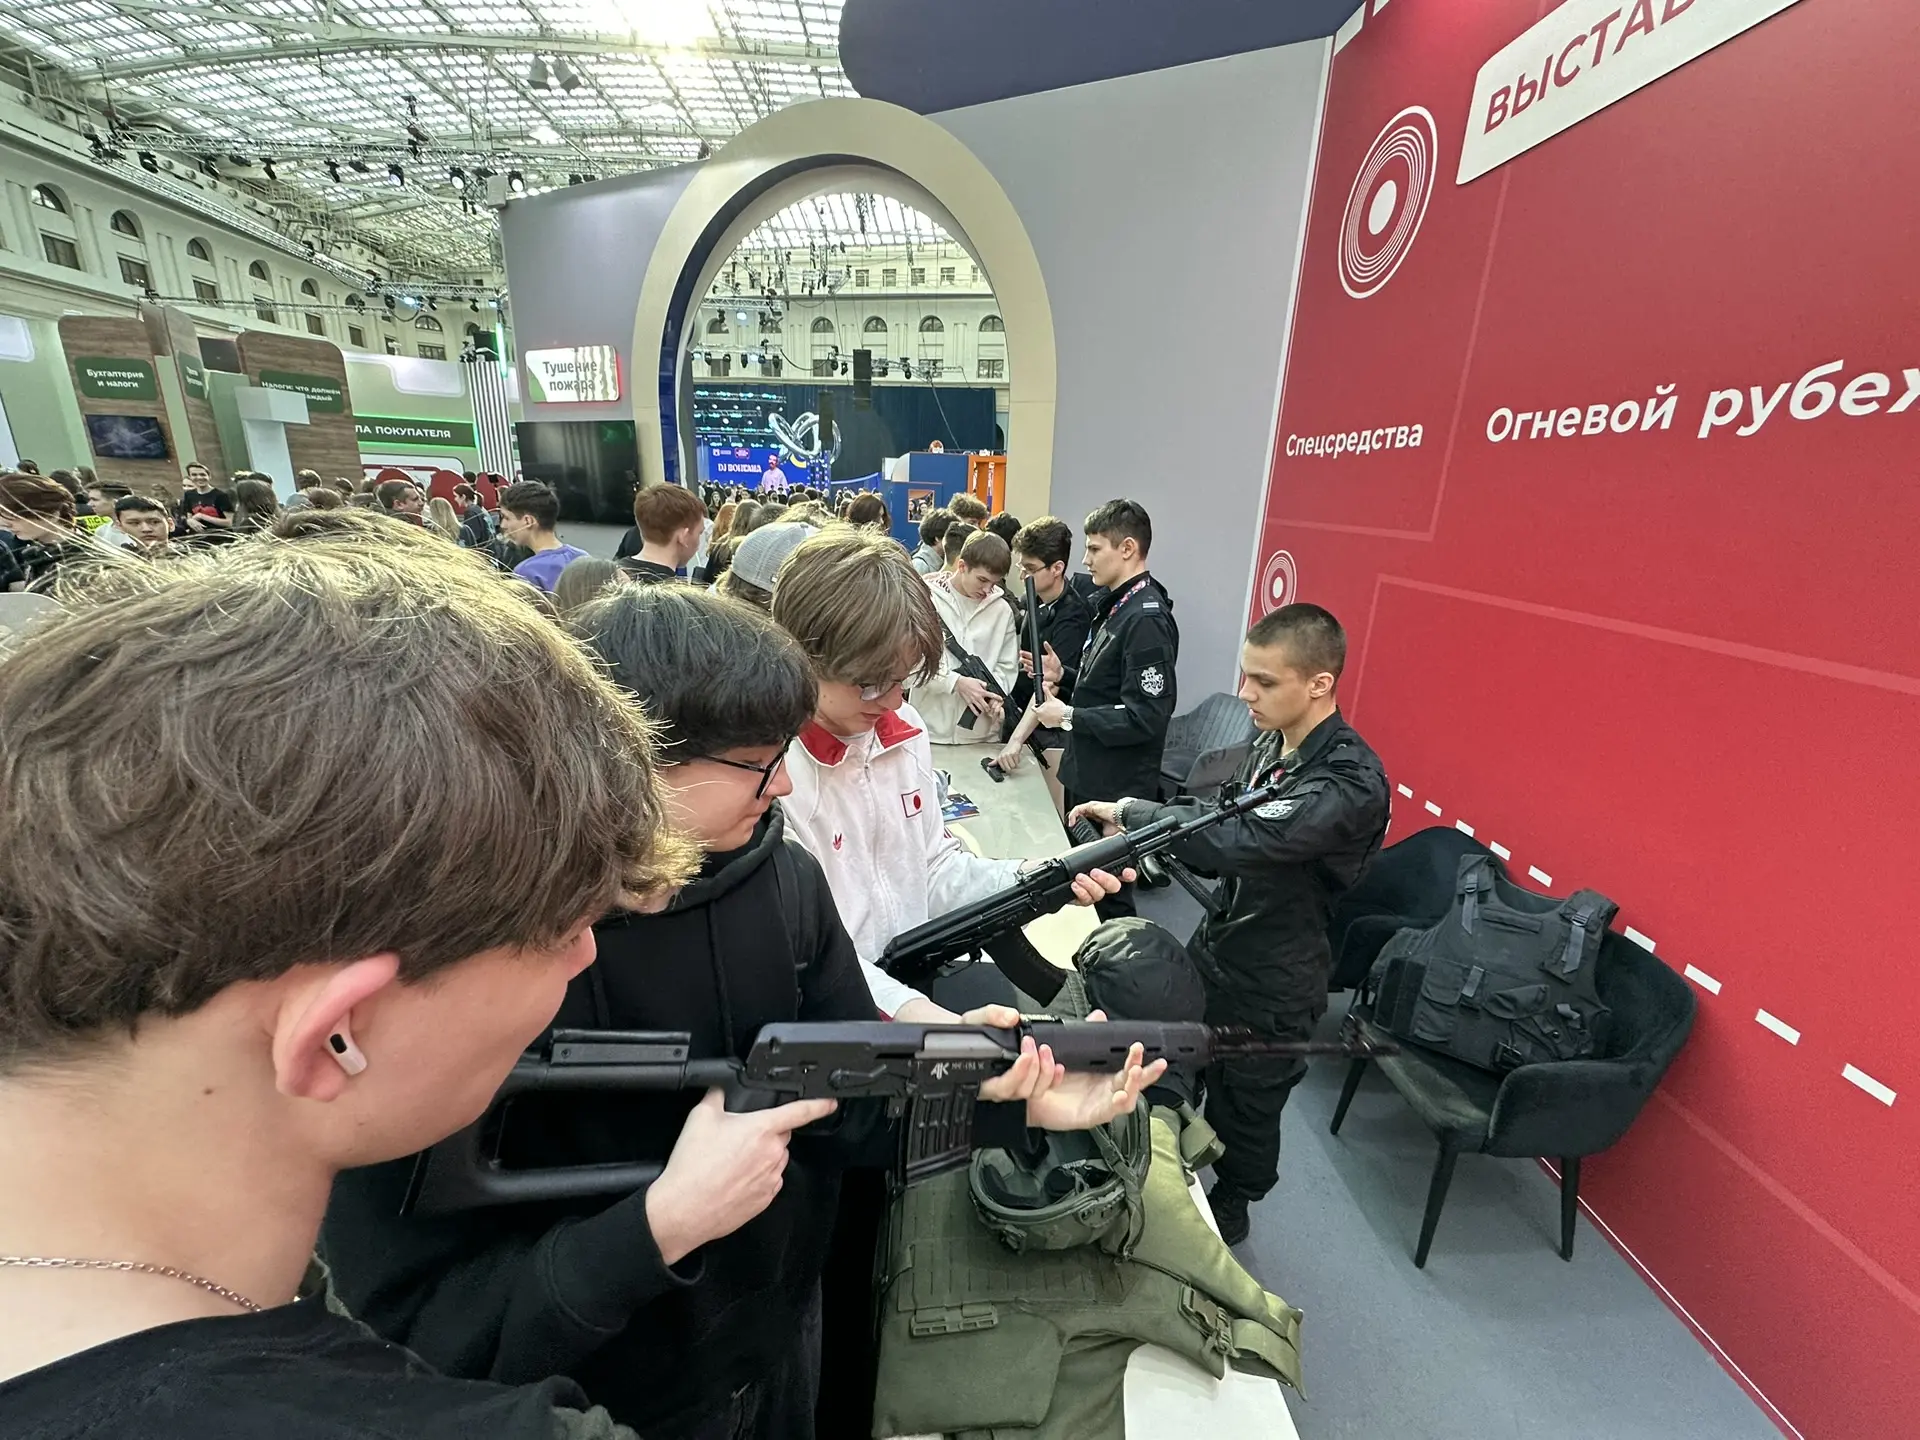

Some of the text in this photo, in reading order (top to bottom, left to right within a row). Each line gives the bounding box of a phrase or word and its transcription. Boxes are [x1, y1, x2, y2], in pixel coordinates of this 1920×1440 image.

[86, 368, 145, 379] Бухгалтерия
[542, 361, 597, 377] Тушение
[549, 380, 595, 393] пожара
[1486, 383, 1678, 443] Огневой
[375, 425, 451, 438] ПОКУПАТЕЛЯ
[1285, 422, 1424, 459] Спецсредства
[717, 463, 727, 472] DJ
